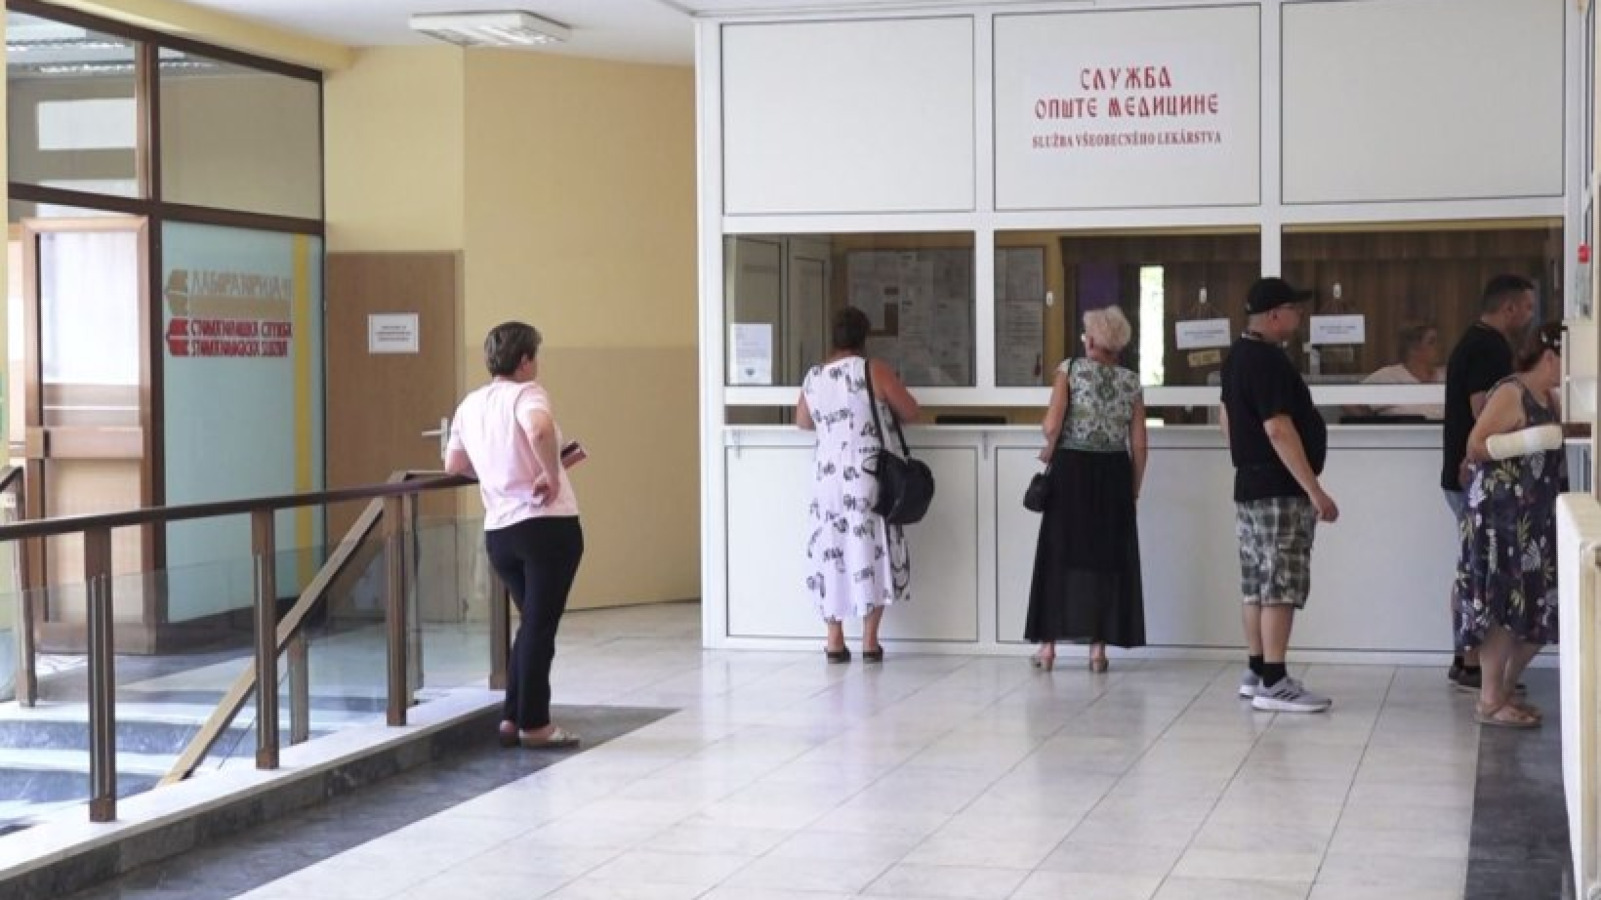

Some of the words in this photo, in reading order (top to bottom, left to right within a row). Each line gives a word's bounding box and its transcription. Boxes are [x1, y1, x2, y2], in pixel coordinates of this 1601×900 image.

[1080, 66, 1172, 91] СЛУЖБА
[1034, 97, 1098, 120] ОПШТЕ
[1108, 93, 1220, 119] МЕДИЦИНЕ
[1032, 131, 1074, 149] SLUŽBA
[1075, 130, 1155, 148] VŠEOBECNÉHO
[1157, 129, 1222, 146] LEKÁRSTVA
